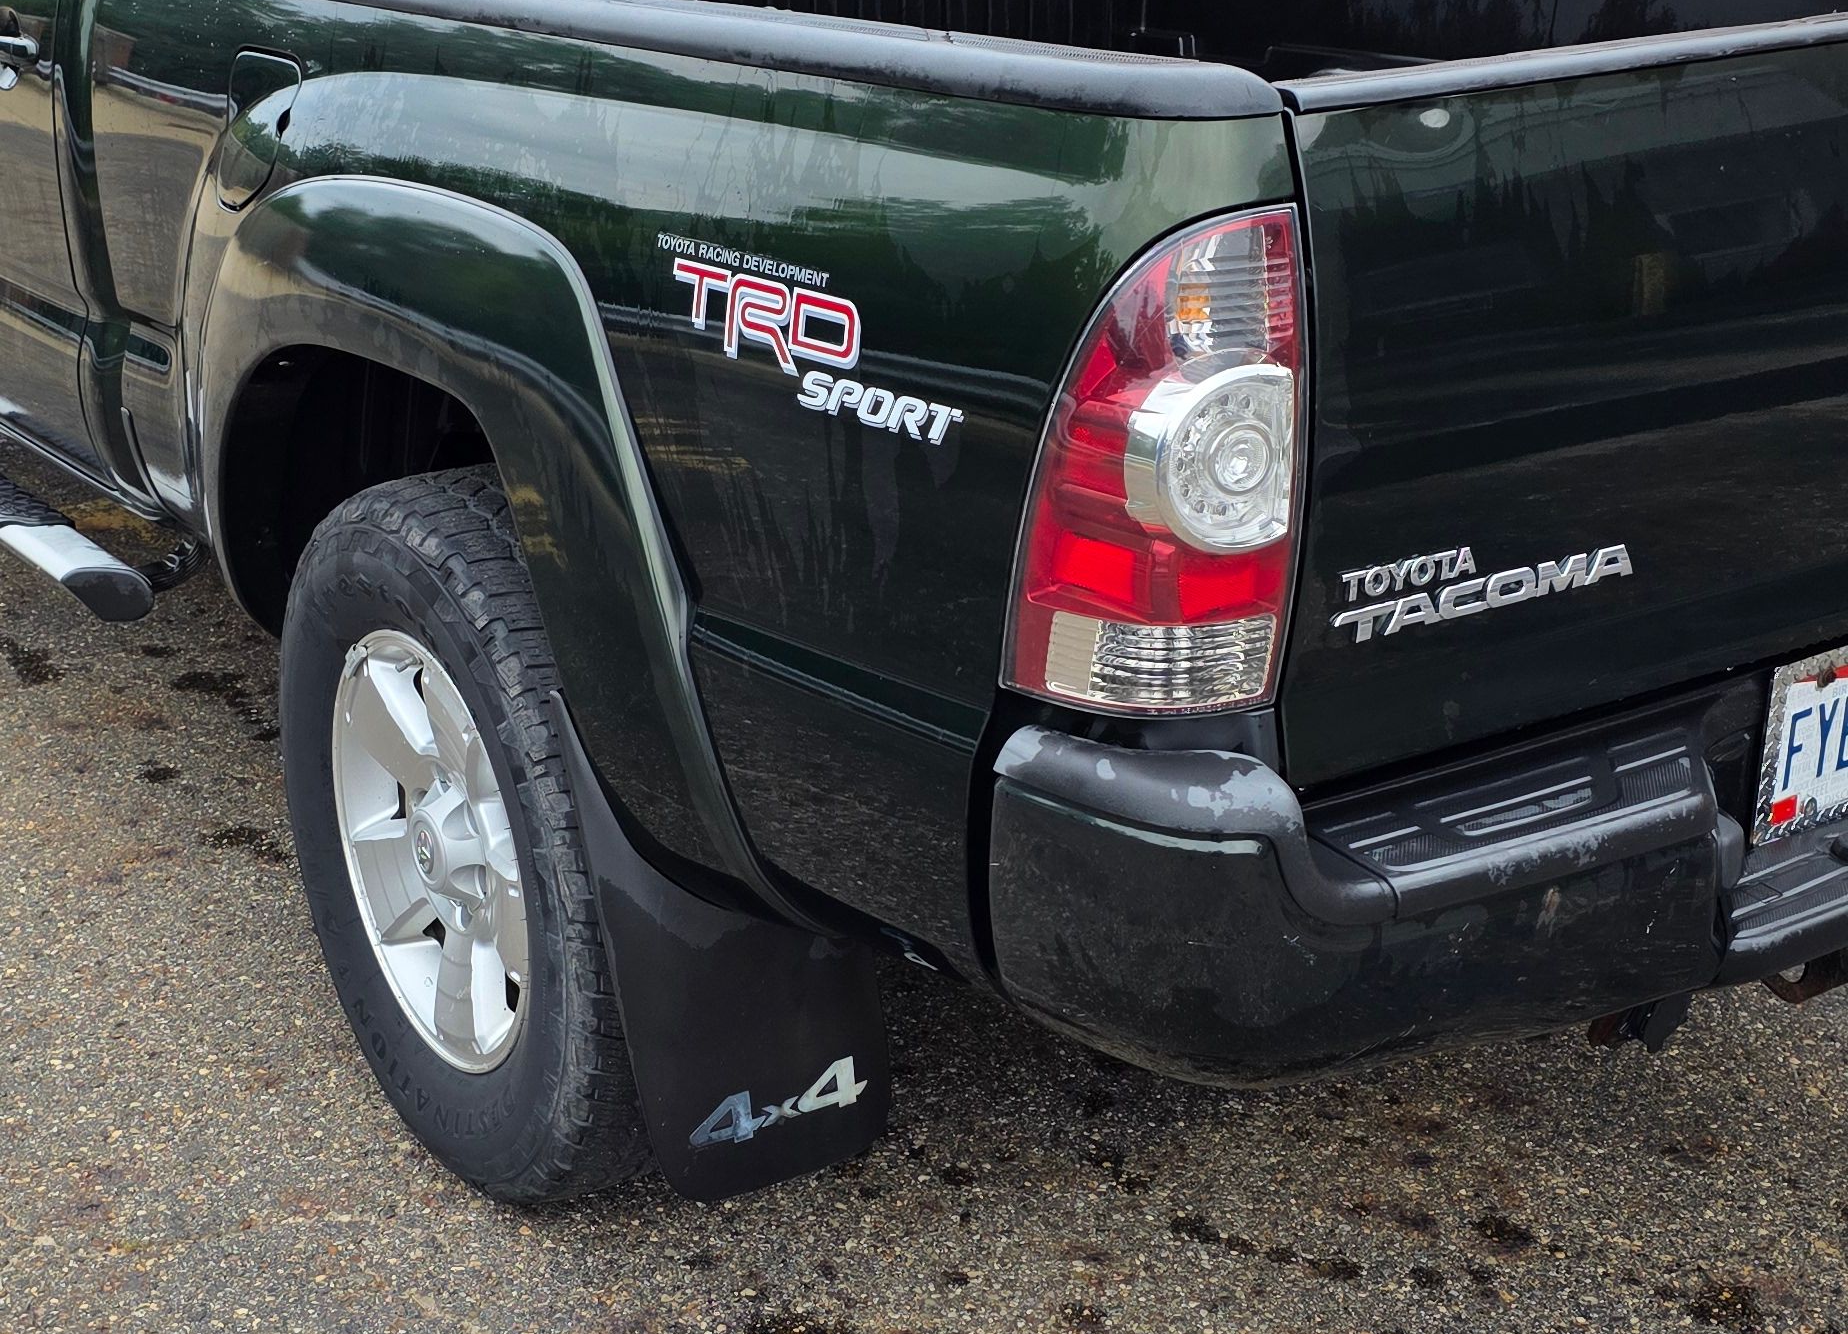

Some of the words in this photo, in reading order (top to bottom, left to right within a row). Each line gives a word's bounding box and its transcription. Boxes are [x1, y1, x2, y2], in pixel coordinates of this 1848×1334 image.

[656, 233, 695, 256] TOYOTA
[698, 244, 741, 267] RACING
[742, 253, 830, 288] DEVELOPMENT
[672, 257, 862, 377] TRD
[796, 370, 965, 446] SPORT
[1329, 544, 1634, 644] TACOMA
[1341, 546, 1477, 602] TOYOTA
